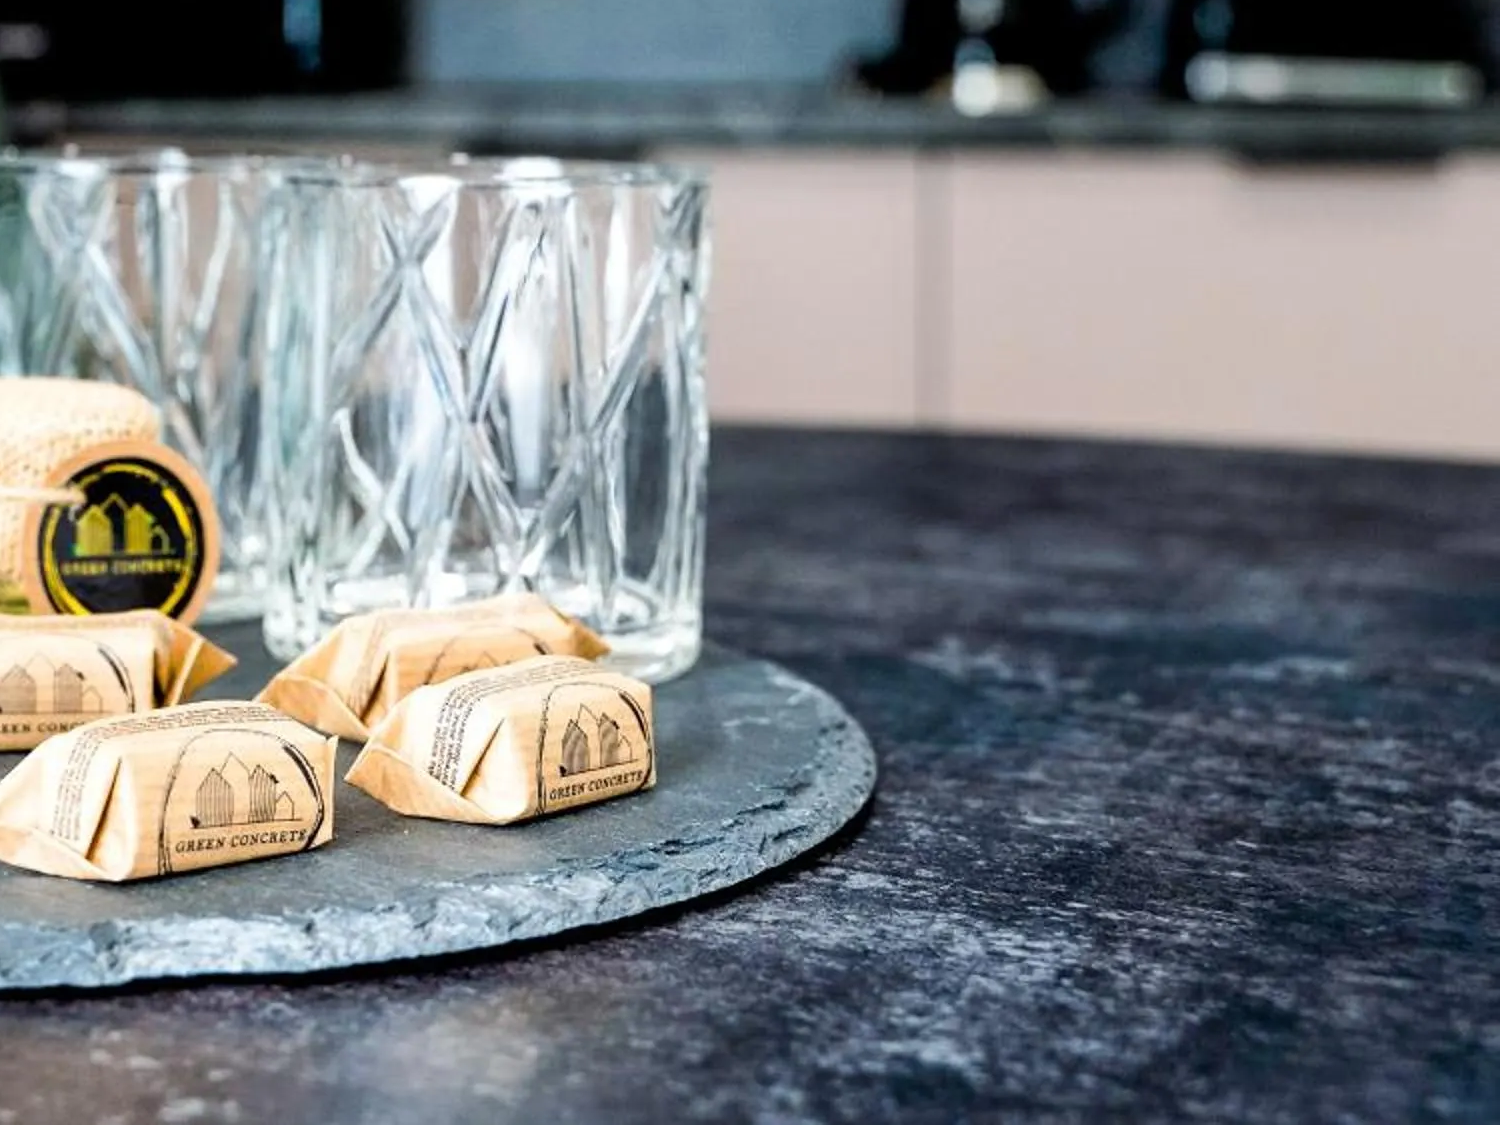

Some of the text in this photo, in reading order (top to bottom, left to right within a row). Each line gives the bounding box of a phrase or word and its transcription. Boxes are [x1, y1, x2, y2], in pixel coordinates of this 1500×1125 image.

[37, 721, 84, 732] CONC
[549, 770, 643, 800] GREEN CONCRETE
[175, 828, 307, 853] GREEN CONCRETE
